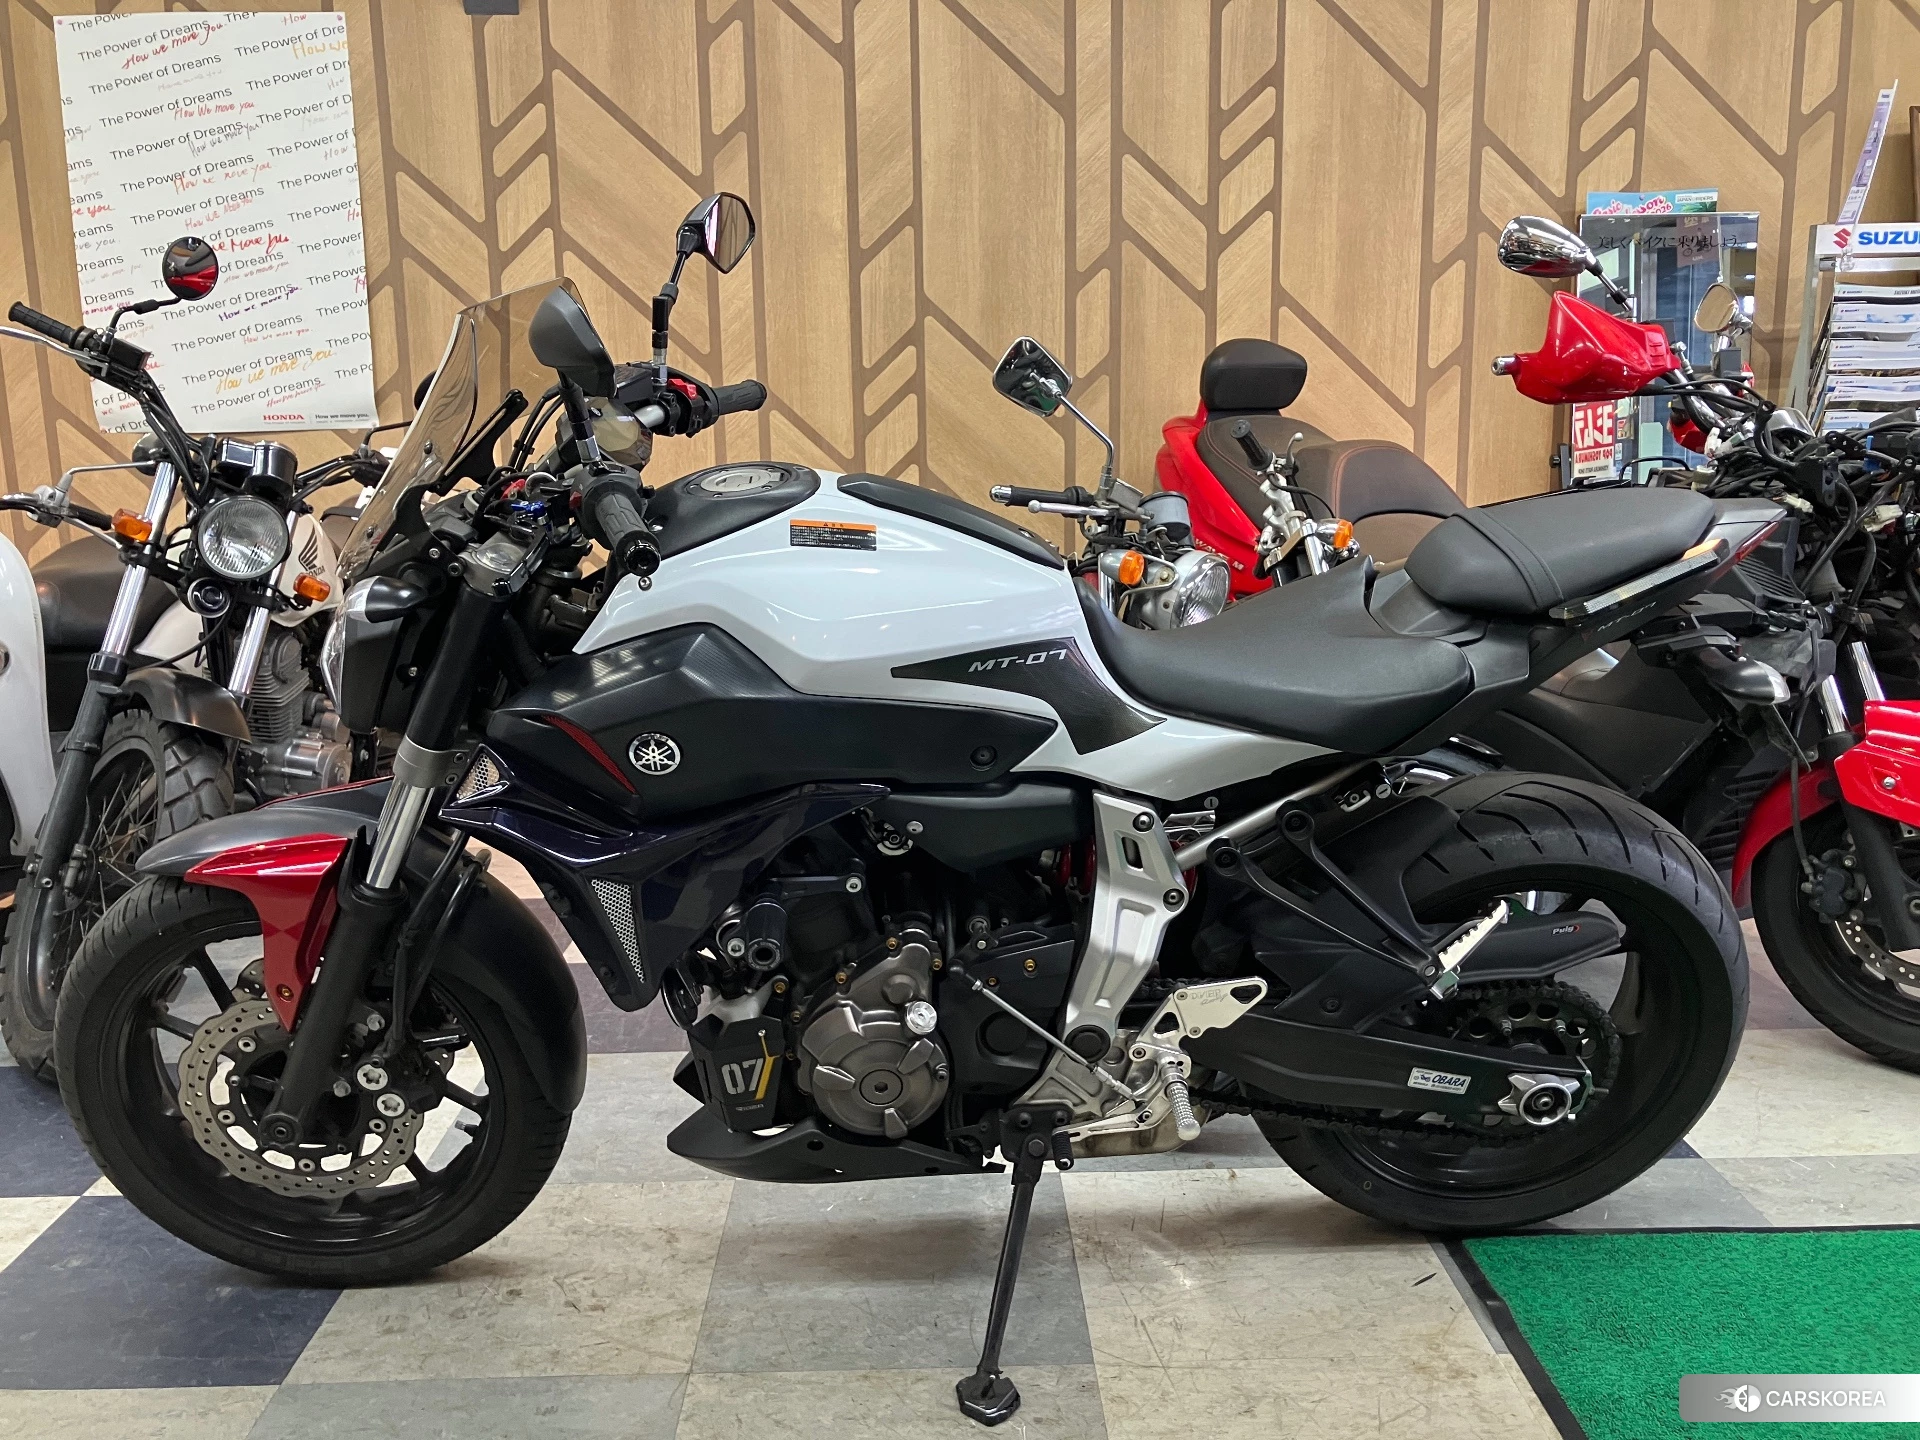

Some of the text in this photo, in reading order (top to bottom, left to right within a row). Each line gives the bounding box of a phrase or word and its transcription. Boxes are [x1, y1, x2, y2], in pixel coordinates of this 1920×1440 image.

[69, 19, 92, 32] The
[224, 12, 250, 23] The
[281, 14, 306, 26] How
[78, 20, 210, 62] The Power of Dreams
[234, 44, 260, 56] The
[262, 34, 302, 51] Power
[306, 29, 318, 40] of
[292, 42, 326, 60] How
[122, 54, 149, 70] How
[152, 44, 168, 56] we
[88, 82, 113, 94] The
[114, 72, 154, 88] Power
[156, 66, 169, 77] of
[172, 54, 222, 74] Dreams
[246, 64, 330, 90] The Power of
[99, 88, 232, 128] The Power of Dreams
[256, 112, 282, 124] The
[284, 102, 324, 119] Power
[326, 97, 340, 108] of
[110, 122, 244, 160] The Power of Dreams
[267, 146, 292, 158] The
[294, 134, 334, 152] Power
[336, 130, 349, 141] of
[120, 154, 254, 192] The Power of Dreams
[277, 178, 302, 190] The
[304, 168, 343, 184] Power
[130, 212, 155, 225] The
[157, 203, 196, 219] Power
[200, 198, 212, 208] of
[216, 187, 264, 205] Dreams
[287, 210, 312, 222] The
[314, 200, 352, 216] Power
[210, 219, 274, 242] of Dreams
[1858, 231, 1920, 245] SUZU
[141, 245, 165, 258] The
[297, 232, 362, 254] The Power
[220, 252, 284, 274] of Dreams
[306, 274, 330, 286] The
[84, 287, 134, 305] Dreams
[162, 283, 293, 320] The Power of Dreams
[316, 306, 340, 318] The
[172, 315, 302, 352] The Power of Dreams
[326, 336, 350, 348] The
[182, 348, 313, 386] The Power of Dreams
[334, 367, 358, 379] The
[102, 394, 114, 404] of
[191, 403, 216, 414] The
[216, 394, 255, 408] Power
[258, 388, 270, 399] of
[274, 376, 321, 395] Dreams
[308, 566, 325, 577] ONDA
[968, 648, 1067, 673] MT-07
[1552, 926, 1574, 935] Puig
[721, 1058, 764, 1095] 07
[1432, 1075, 1466, 1087] OBARA
